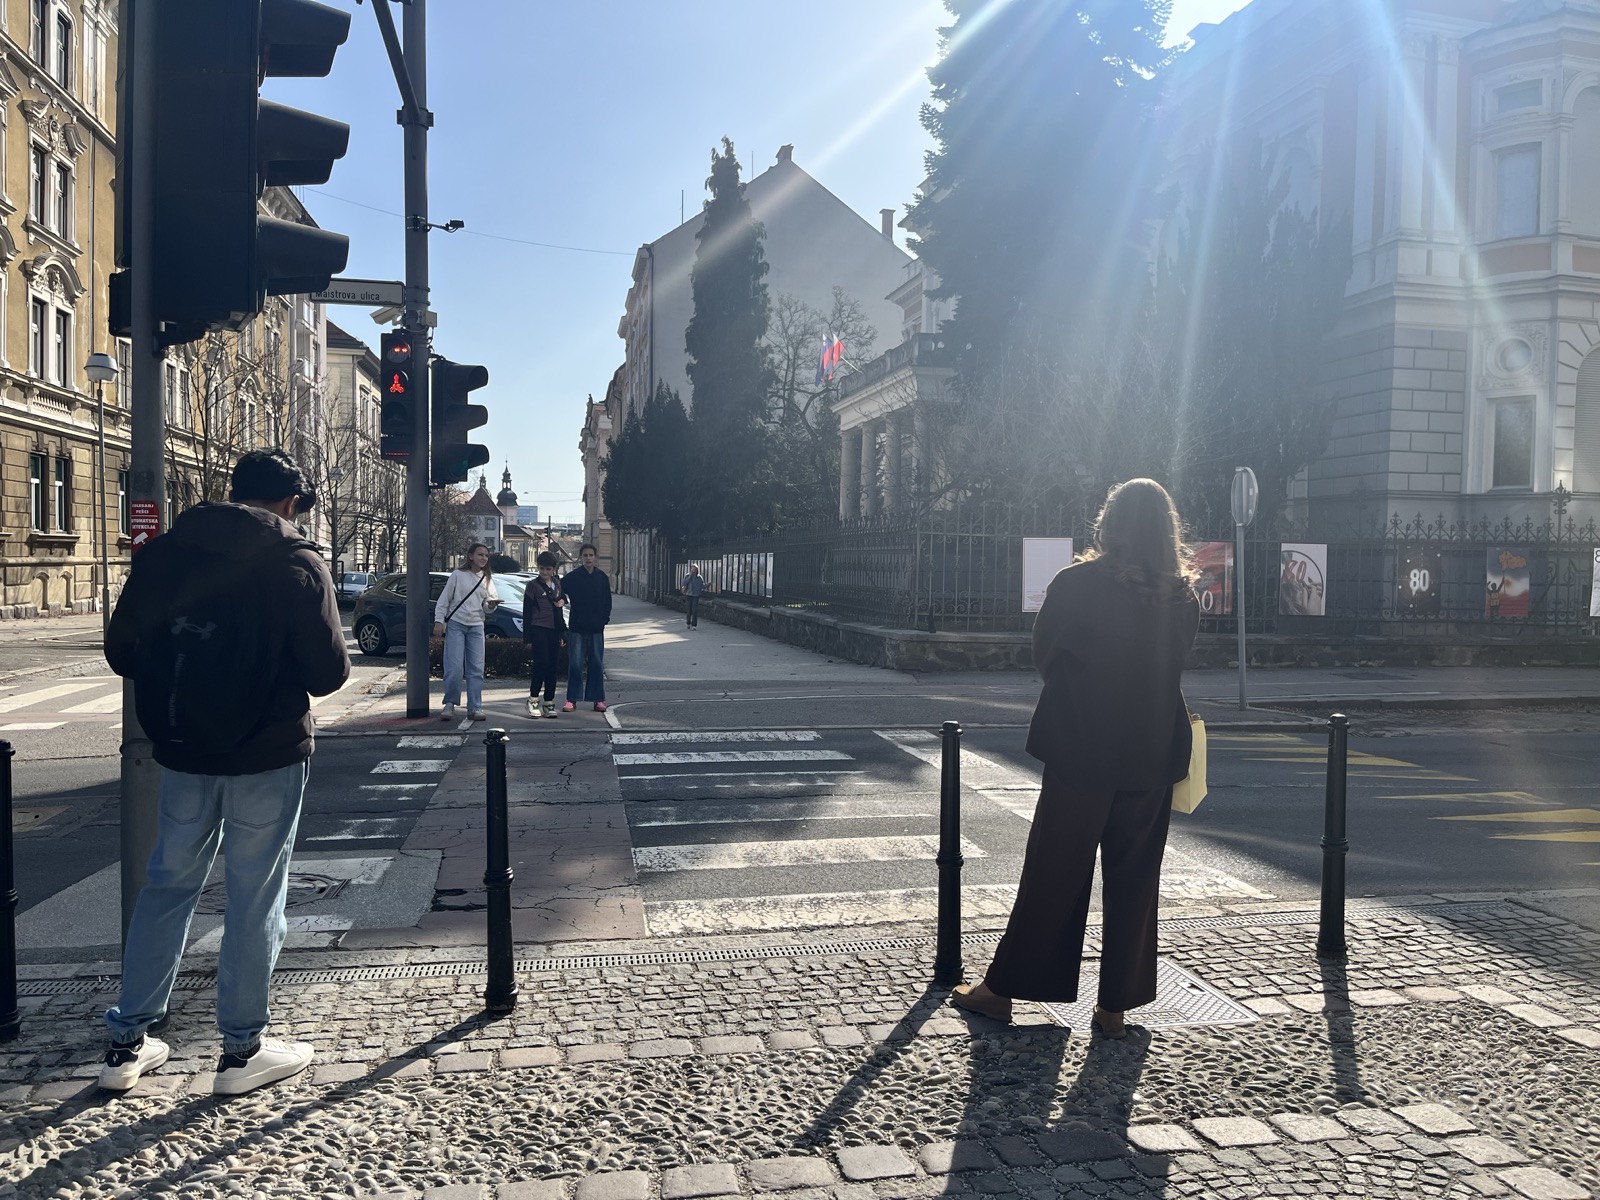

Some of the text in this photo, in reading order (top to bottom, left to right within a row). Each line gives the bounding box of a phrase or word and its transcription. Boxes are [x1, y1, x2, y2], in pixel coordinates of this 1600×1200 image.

[315, 290, 380, 300] Maistrova ulica
[1410, 569, 1429, 592] 80
